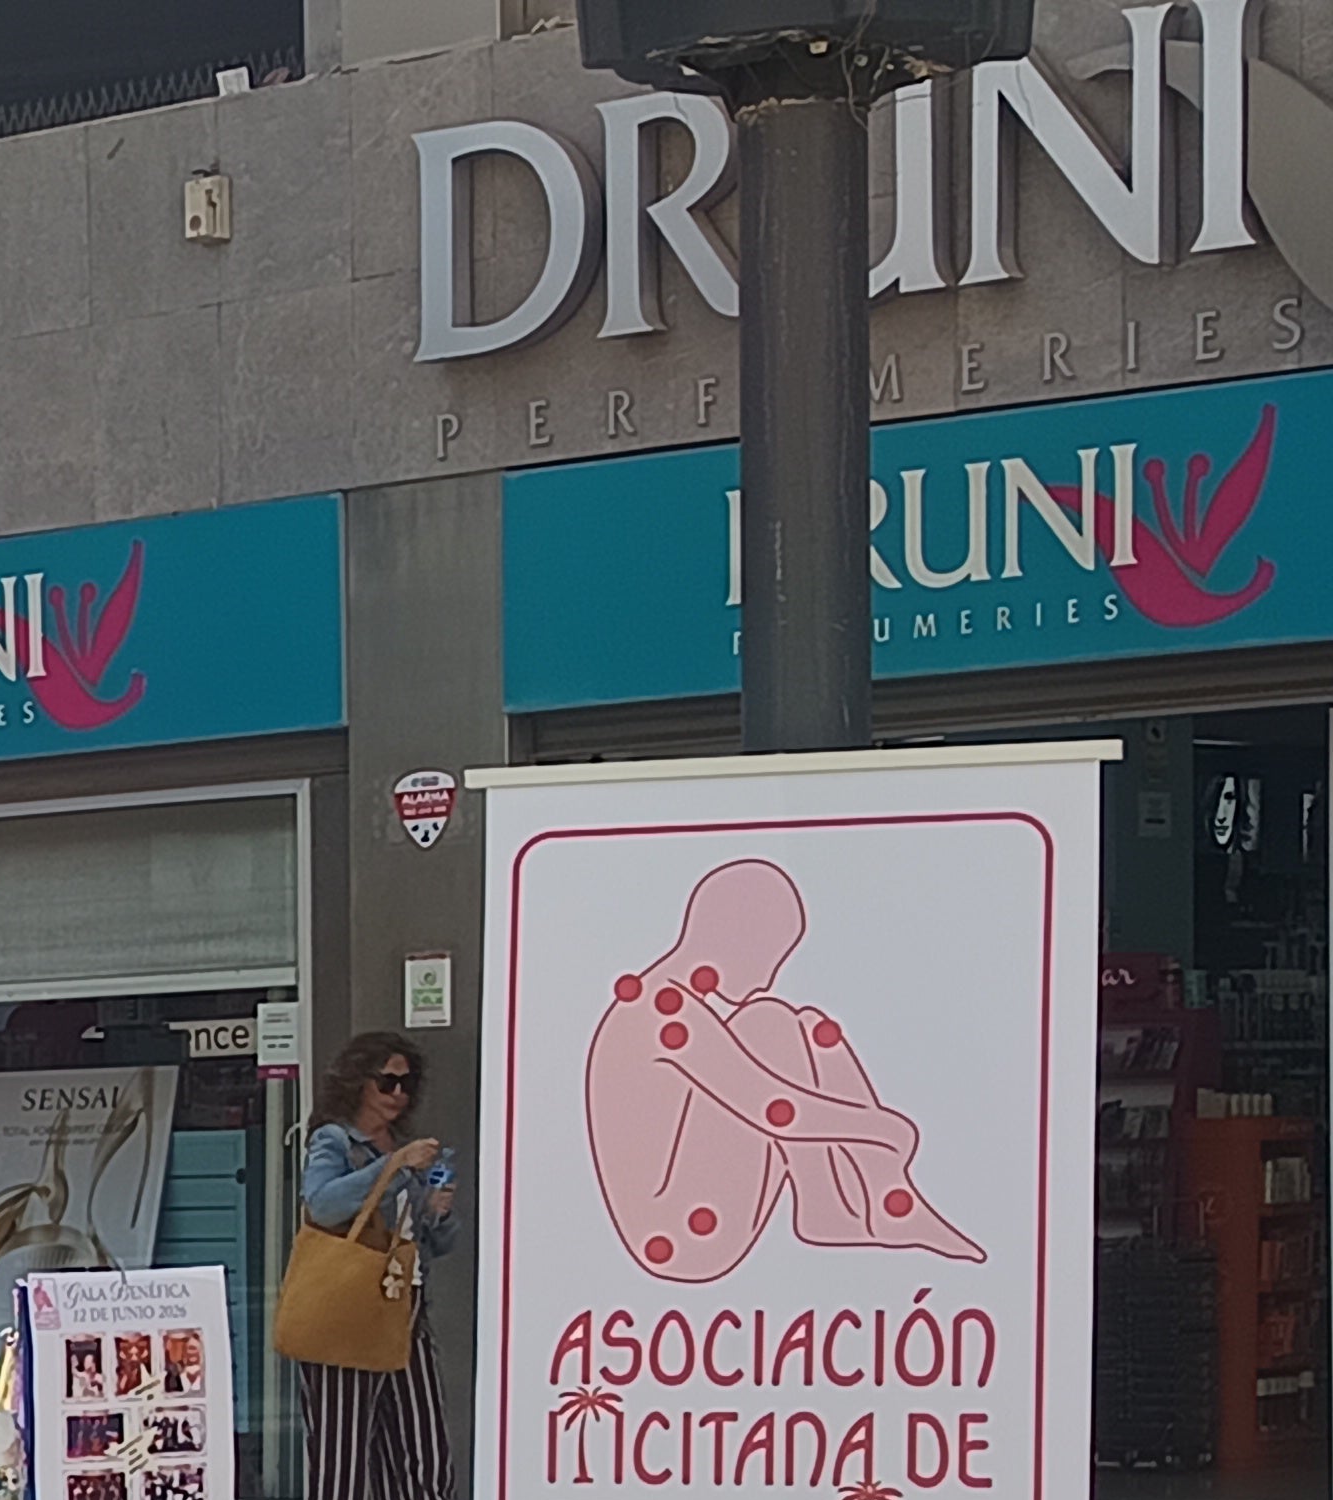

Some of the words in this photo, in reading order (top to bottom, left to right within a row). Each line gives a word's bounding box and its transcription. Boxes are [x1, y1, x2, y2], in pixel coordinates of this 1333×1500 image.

[436, 298, 1303, 461] PERFMERIES
[725, 442, 1139, 607] UNI
[733, 593, 1119, 656] UMERIES
[186, 1024, 251, 1051] nce
[21, 1085, 120, 1113] SENSAI
[90, 1307, 109, 1322] DE
[111, 1304, 156, 1323] JUNIO
[549, 1287, 997, 1388] ASOCIACIÓN
[906, 1412, 994, 1489] DE
